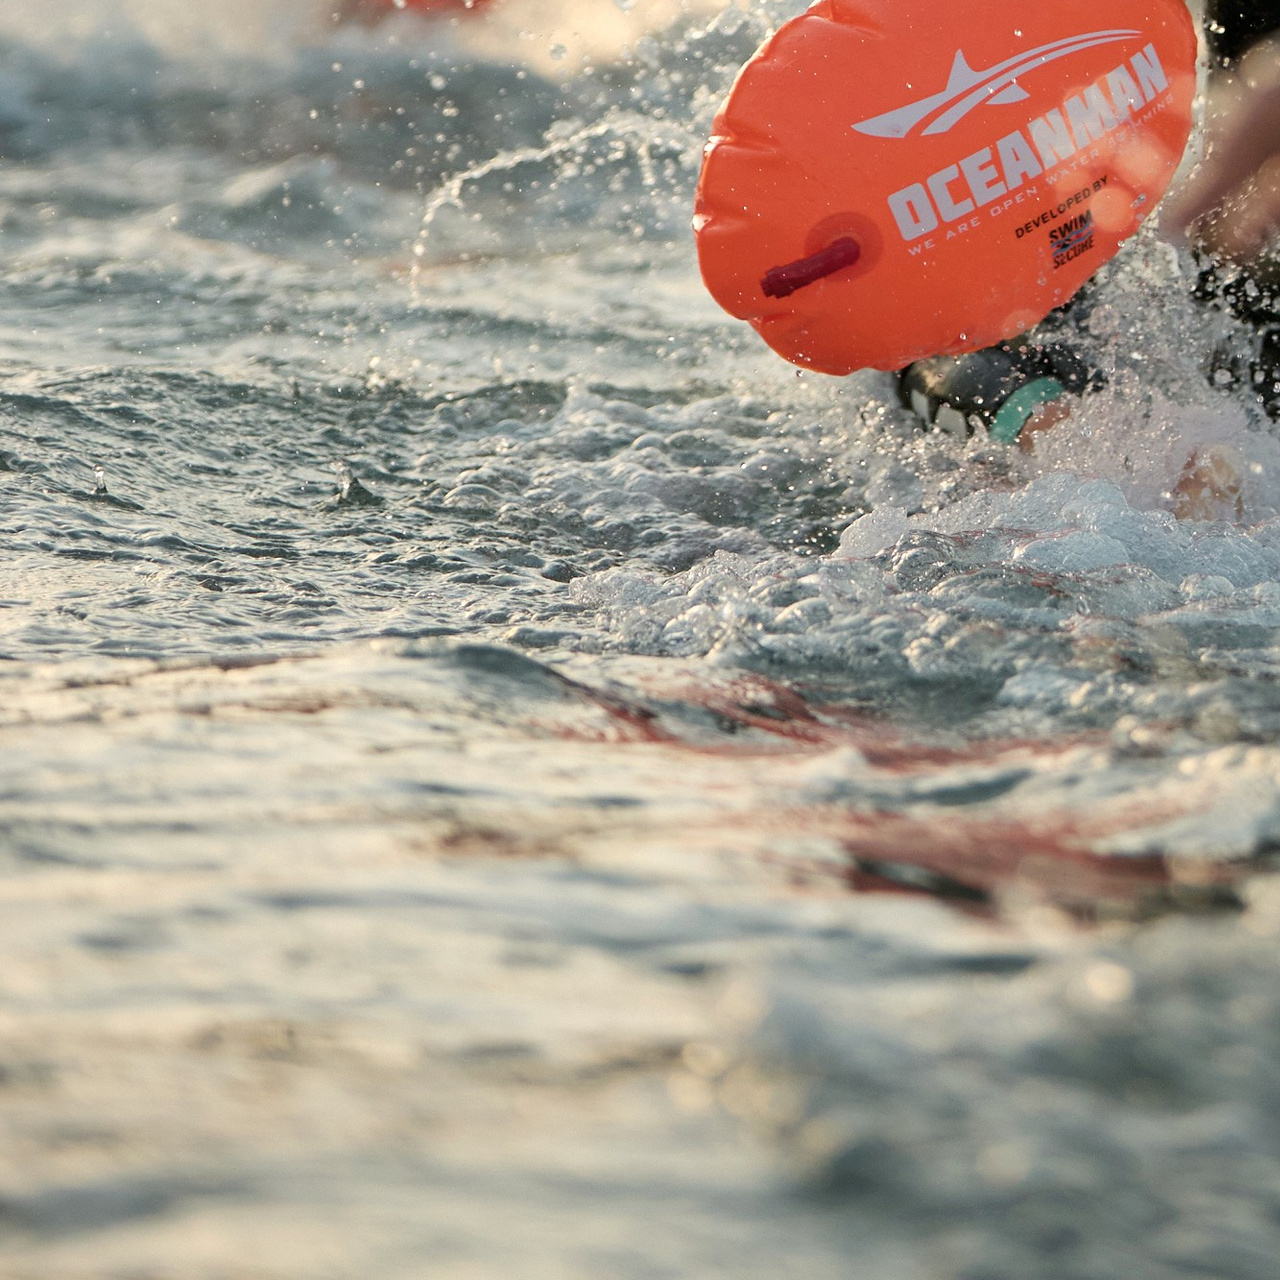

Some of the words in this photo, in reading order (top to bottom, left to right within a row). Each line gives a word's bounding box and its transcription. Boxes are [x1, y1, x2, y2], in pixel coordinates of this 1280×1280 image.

[886, 42, 1168, 241] OCEANMAN
[907, 239, 936, 257] WE
[945, 216, 981, 240] ARE
[990, 186, 1038, 218] OPEN
[1045, 149, 1099, 186] WATER
[1108, 94, 1173, 145] SWMMING
[1014, 187, 1091, 239] DEVELOPED
[1092, 174, 1108, 192] BY
[1049, 209, 1093, 243] SWIM
[1053, 235, 1094, 269] SECURE
